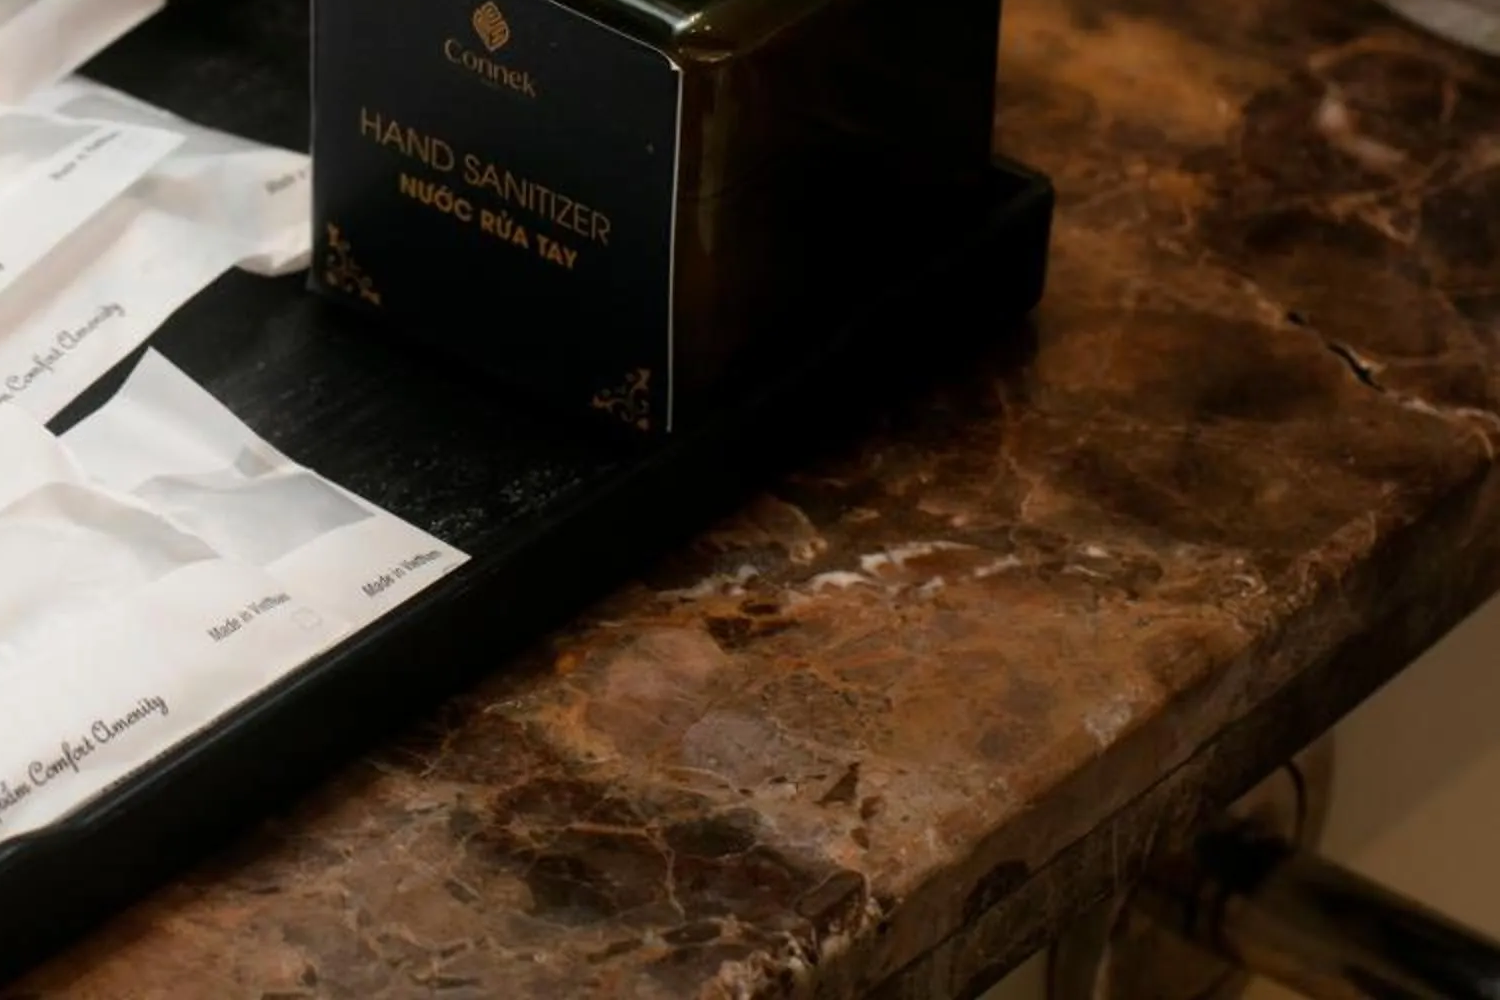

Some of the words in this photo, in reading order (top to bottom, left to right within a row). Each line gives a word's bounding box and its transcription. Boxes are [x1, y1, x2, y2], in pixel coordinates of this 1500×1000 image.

[444, 37, 536, 99] Connek
[360, 106, 455, 172] HAND
[463, 153, 611, 247] SANITIZER
[399, 172, 473, 223] NƯỚC
[480, 208, 530, 249] RỬA
[537, 233, 578, 270] TAY
[361, 575, 396, 599] Made
[206, 613, 243, 643] Made
[27, 736, 97, 788] Comfort
[91, 695, 169, 745] Amenity
